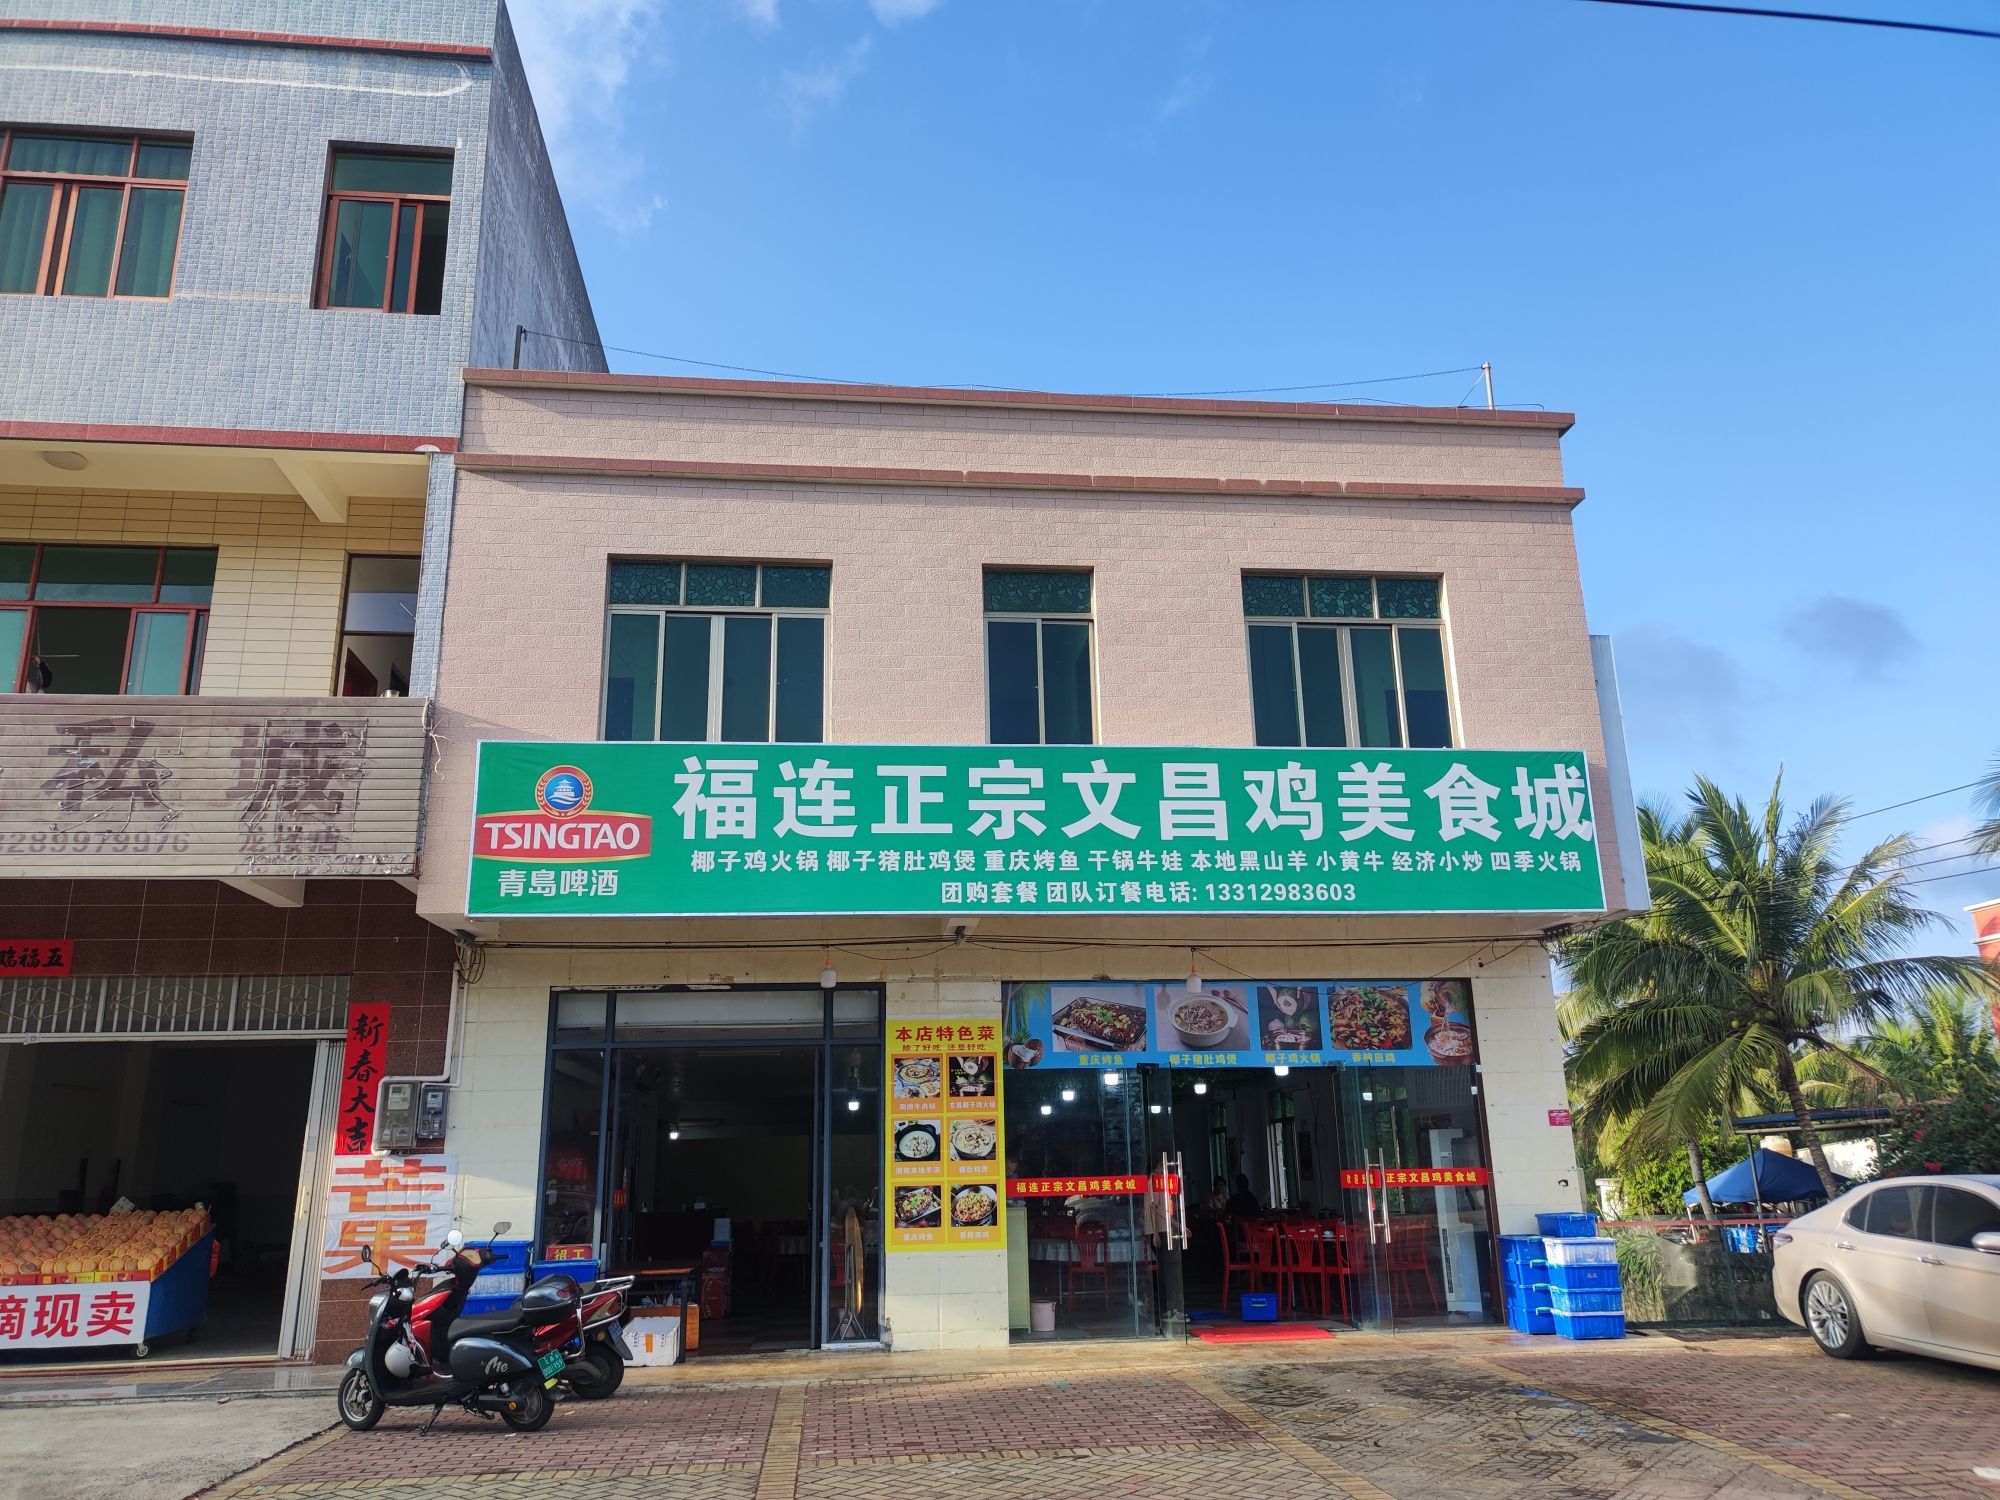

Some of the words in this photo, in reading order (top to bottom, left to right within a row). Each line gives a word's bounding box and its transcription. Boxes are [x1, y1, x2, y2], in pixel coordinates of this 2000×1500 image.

[672, 756, 1592, 842] 福连正宗文昌鸡美食城
[483, 823, 640, 850] TSINGTAO
[691, 850, 819, 872] 椰子鸡火锅
[827, 849, 975, 872] 椰子猪肚鸡煲
[984, 849, 1080, 872] 重庆烤鱼
[1190, 849, 1308, 872] 本地黑山羊
[1316, 850, 1385, 872] 小黄牛
[1391, 850, 1483, 872] 经济小炒
[1490, 850, 1582, 872] 四季火锅
[498, 869, 619, 897] 青岛啤酒
[941, 881, 1038, 904] 团购套餐
[1204, 883, 1356, 902] 13312983603
[895, 1026, 995, 1042] 本店特色菜
[1078, 1054, 1124, 1066] 重庆烤鱼
[1169, 1053, 1237, 1065] 椰子猪肚鸡煲
[1265, 1053, 1321, 1064] 椰子鸡火锅
[344, 1013, 384, 1152] 新春大吉
[1016, 1178, 1136, 1193] 福连正宗文昌鸡美食城
[323, 1158, 447, 1276] 芒果
[554, 1249, 586, 1260] 招工
[485, 1356, 509, 1376] Me
